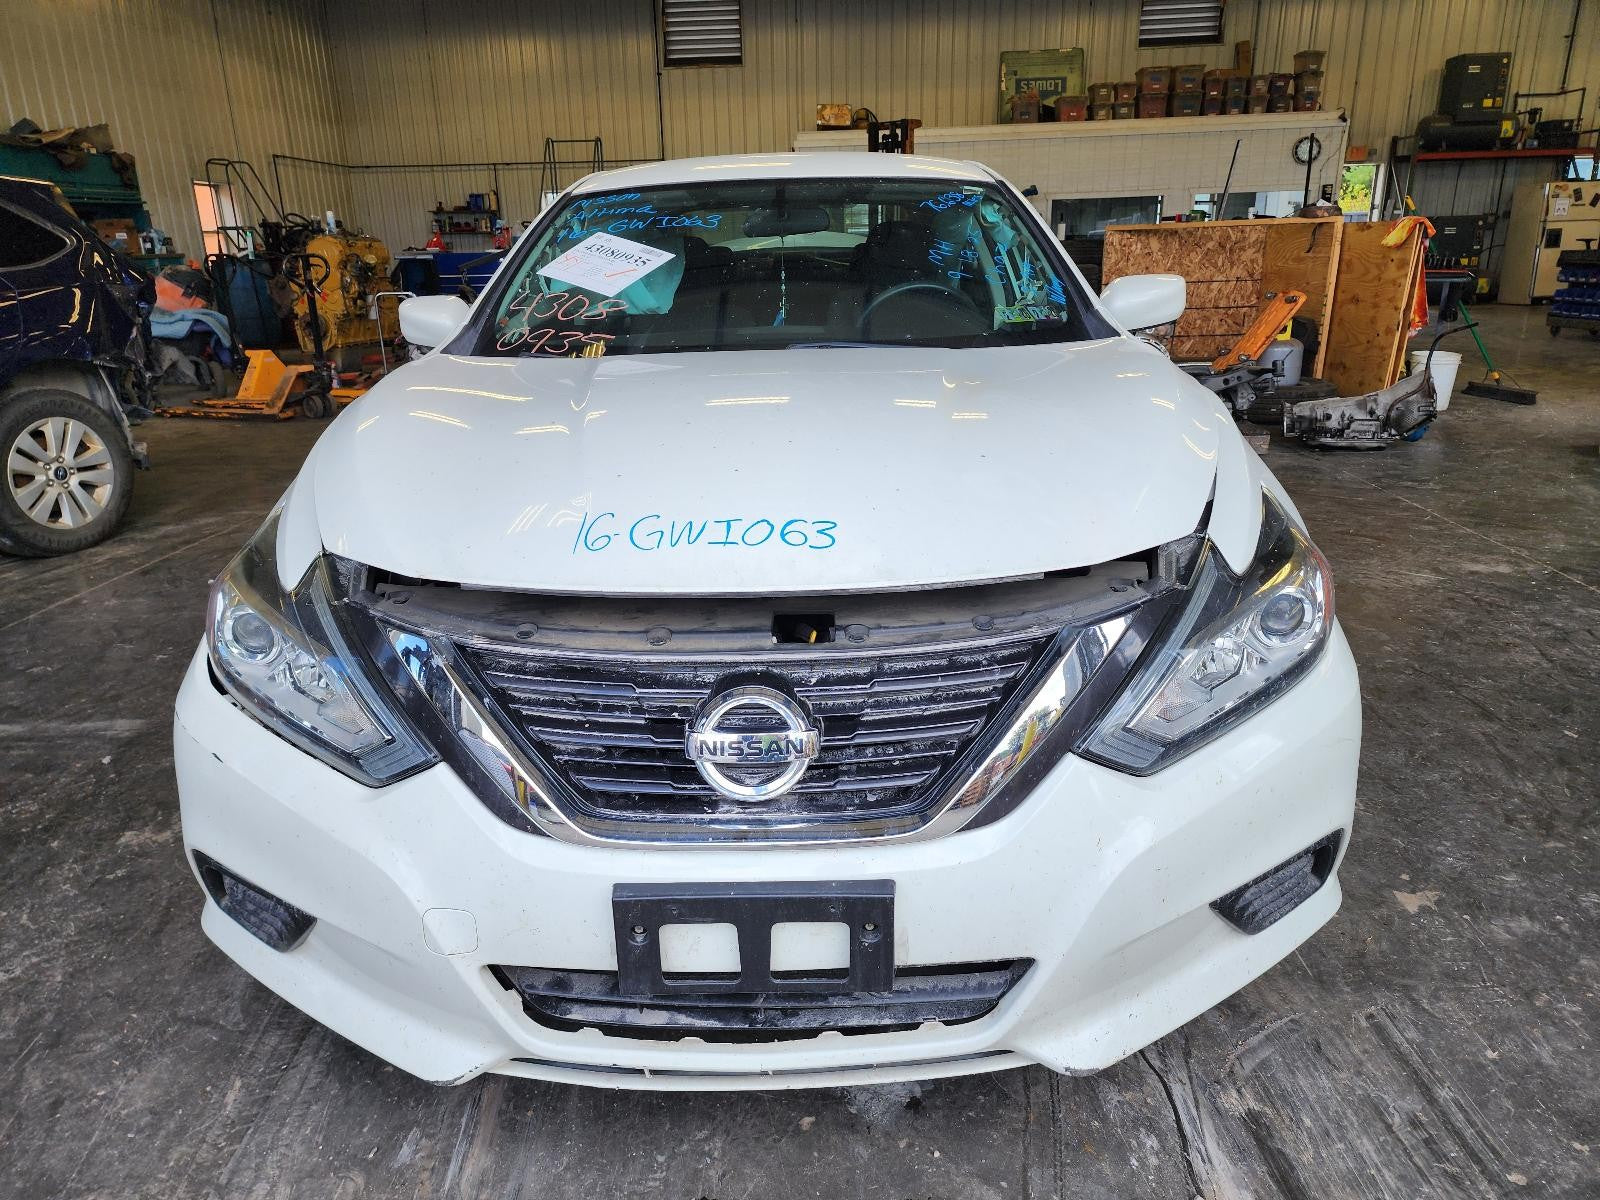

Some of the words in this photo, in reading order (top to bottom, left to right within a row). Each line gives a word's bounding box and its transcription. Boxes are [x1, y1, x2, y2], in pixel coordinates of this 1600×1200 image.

[509, 291, 630, 323] 4308
[496, 327, 616, 355] 0935
[699, 738, 804, 758] NISSAN
